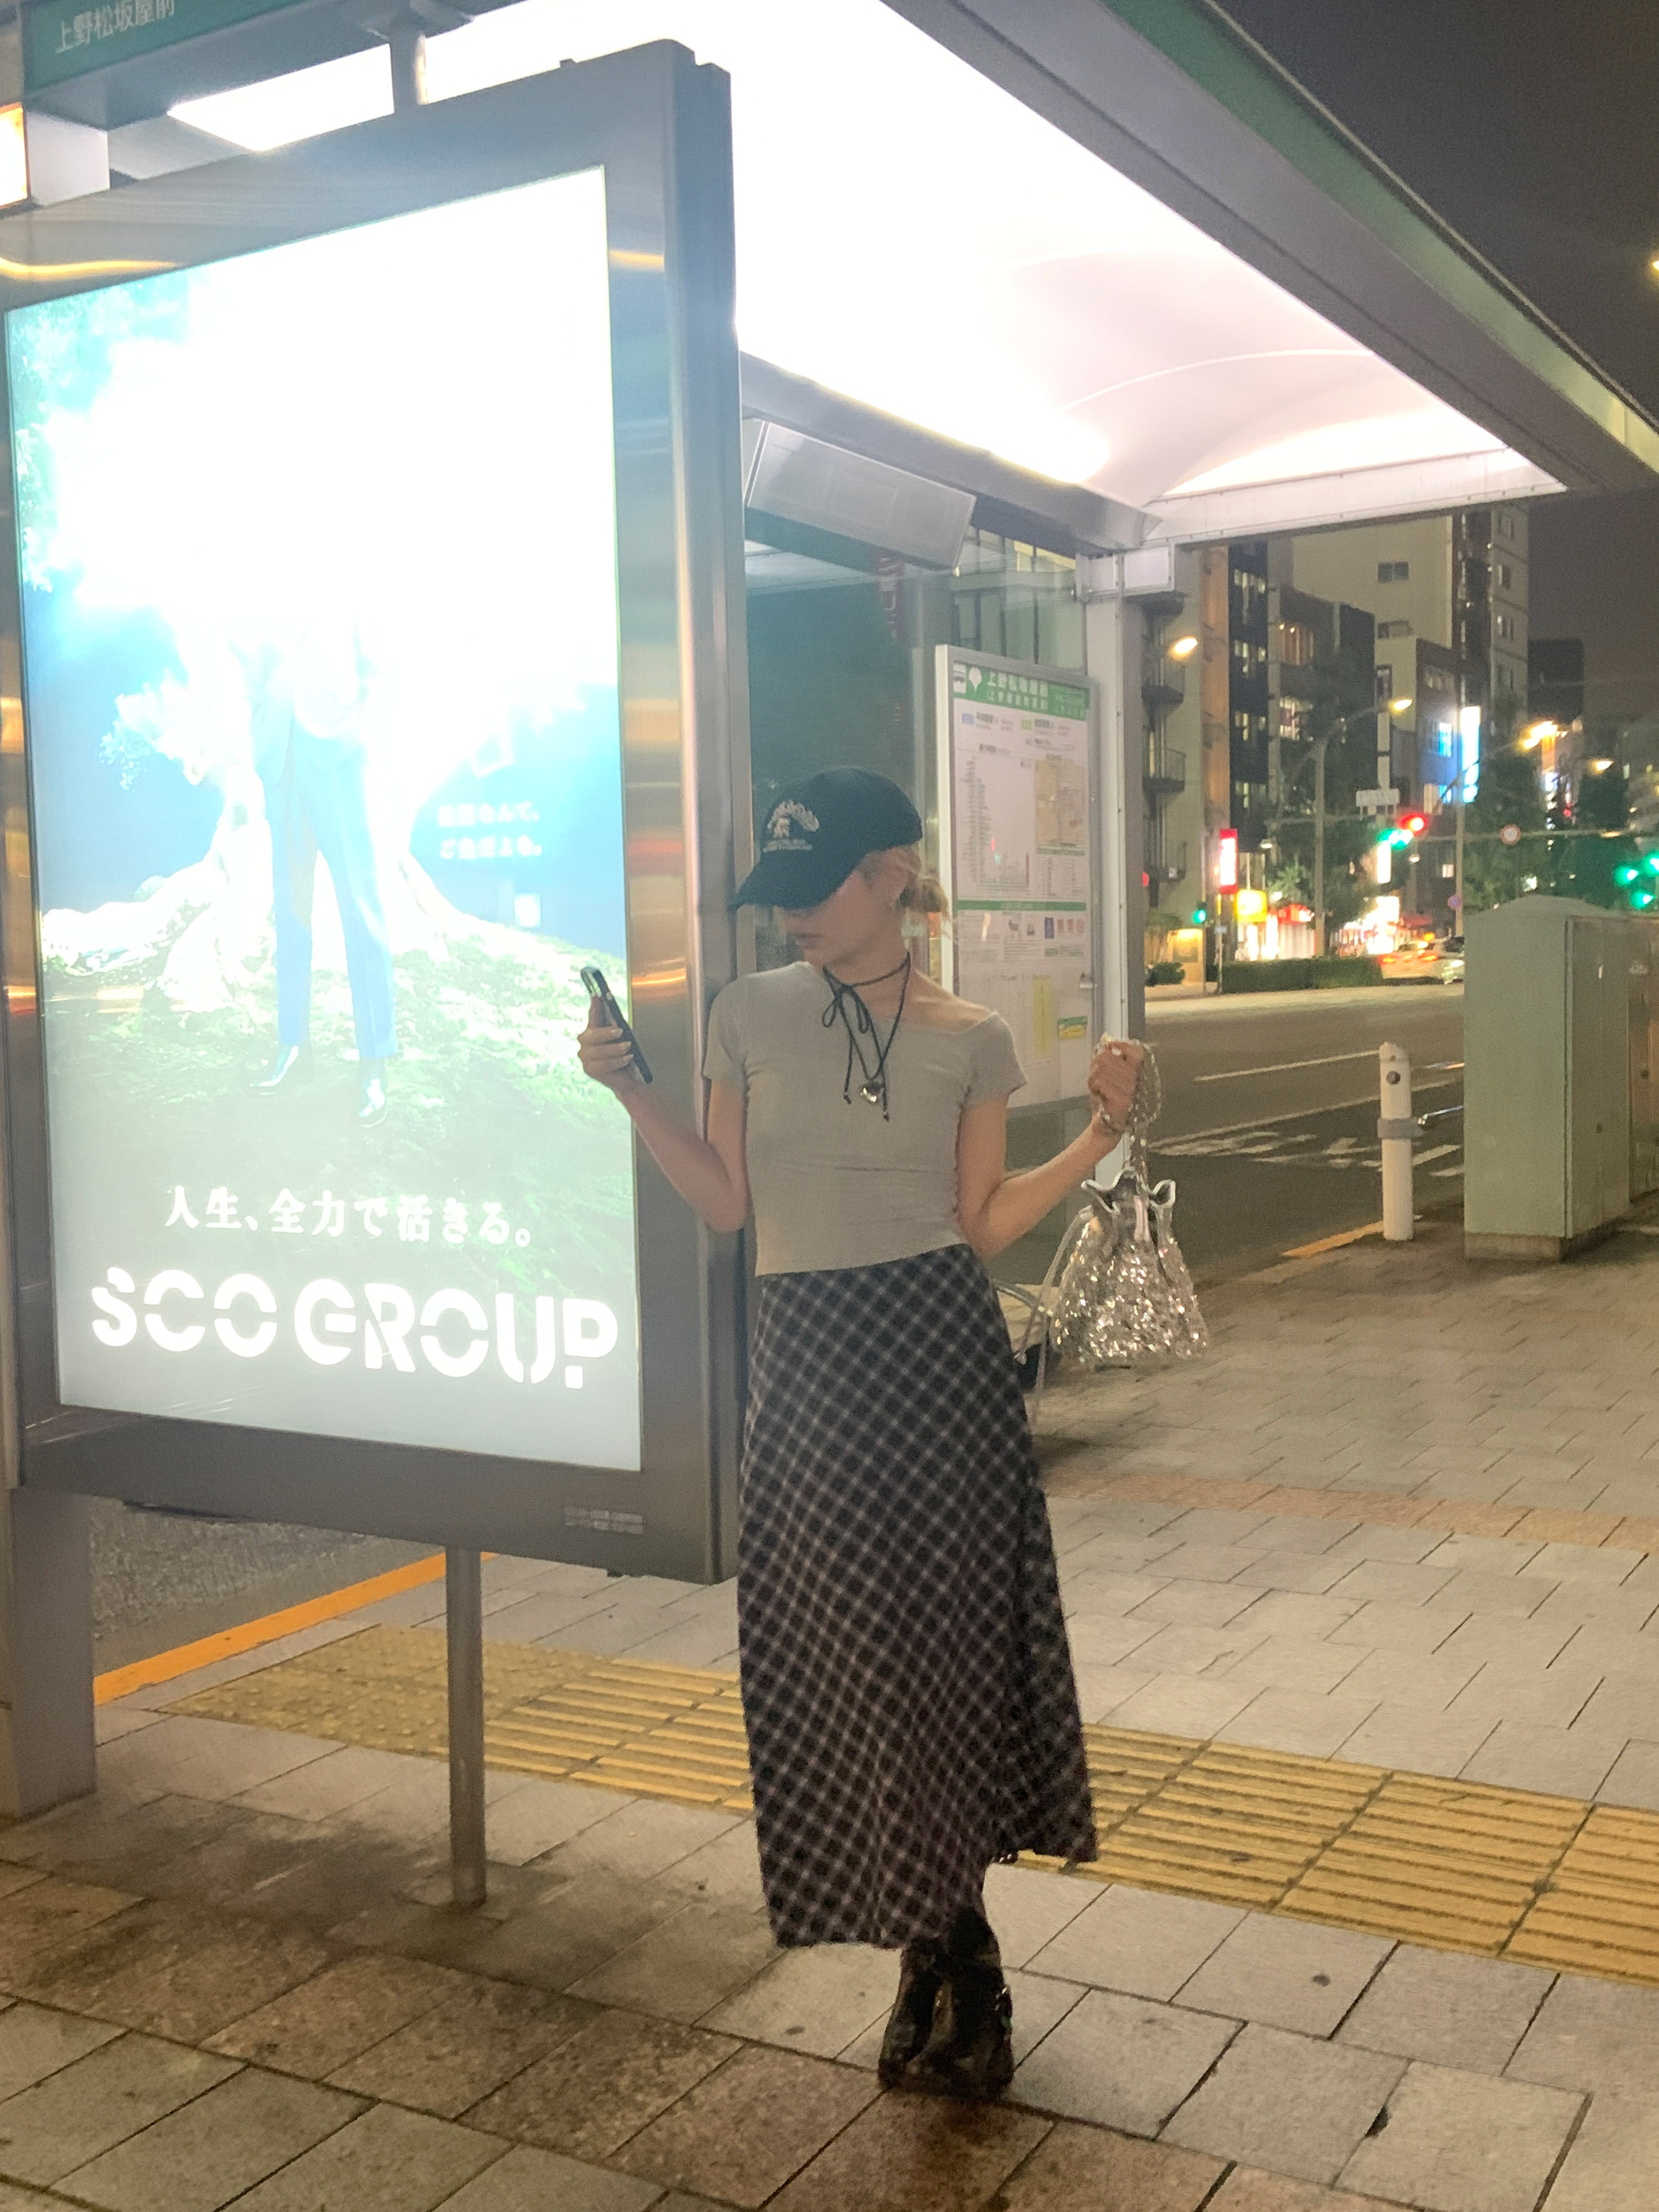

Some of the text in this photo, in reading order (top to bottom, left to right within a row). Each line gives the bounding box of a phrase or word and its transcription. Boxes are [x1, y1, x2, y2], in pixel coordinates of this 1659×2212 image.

[165, 1184, 531, 1248] 人生、全力で活きる。
[91, 1267, 619, 1389] SCO GROUP
